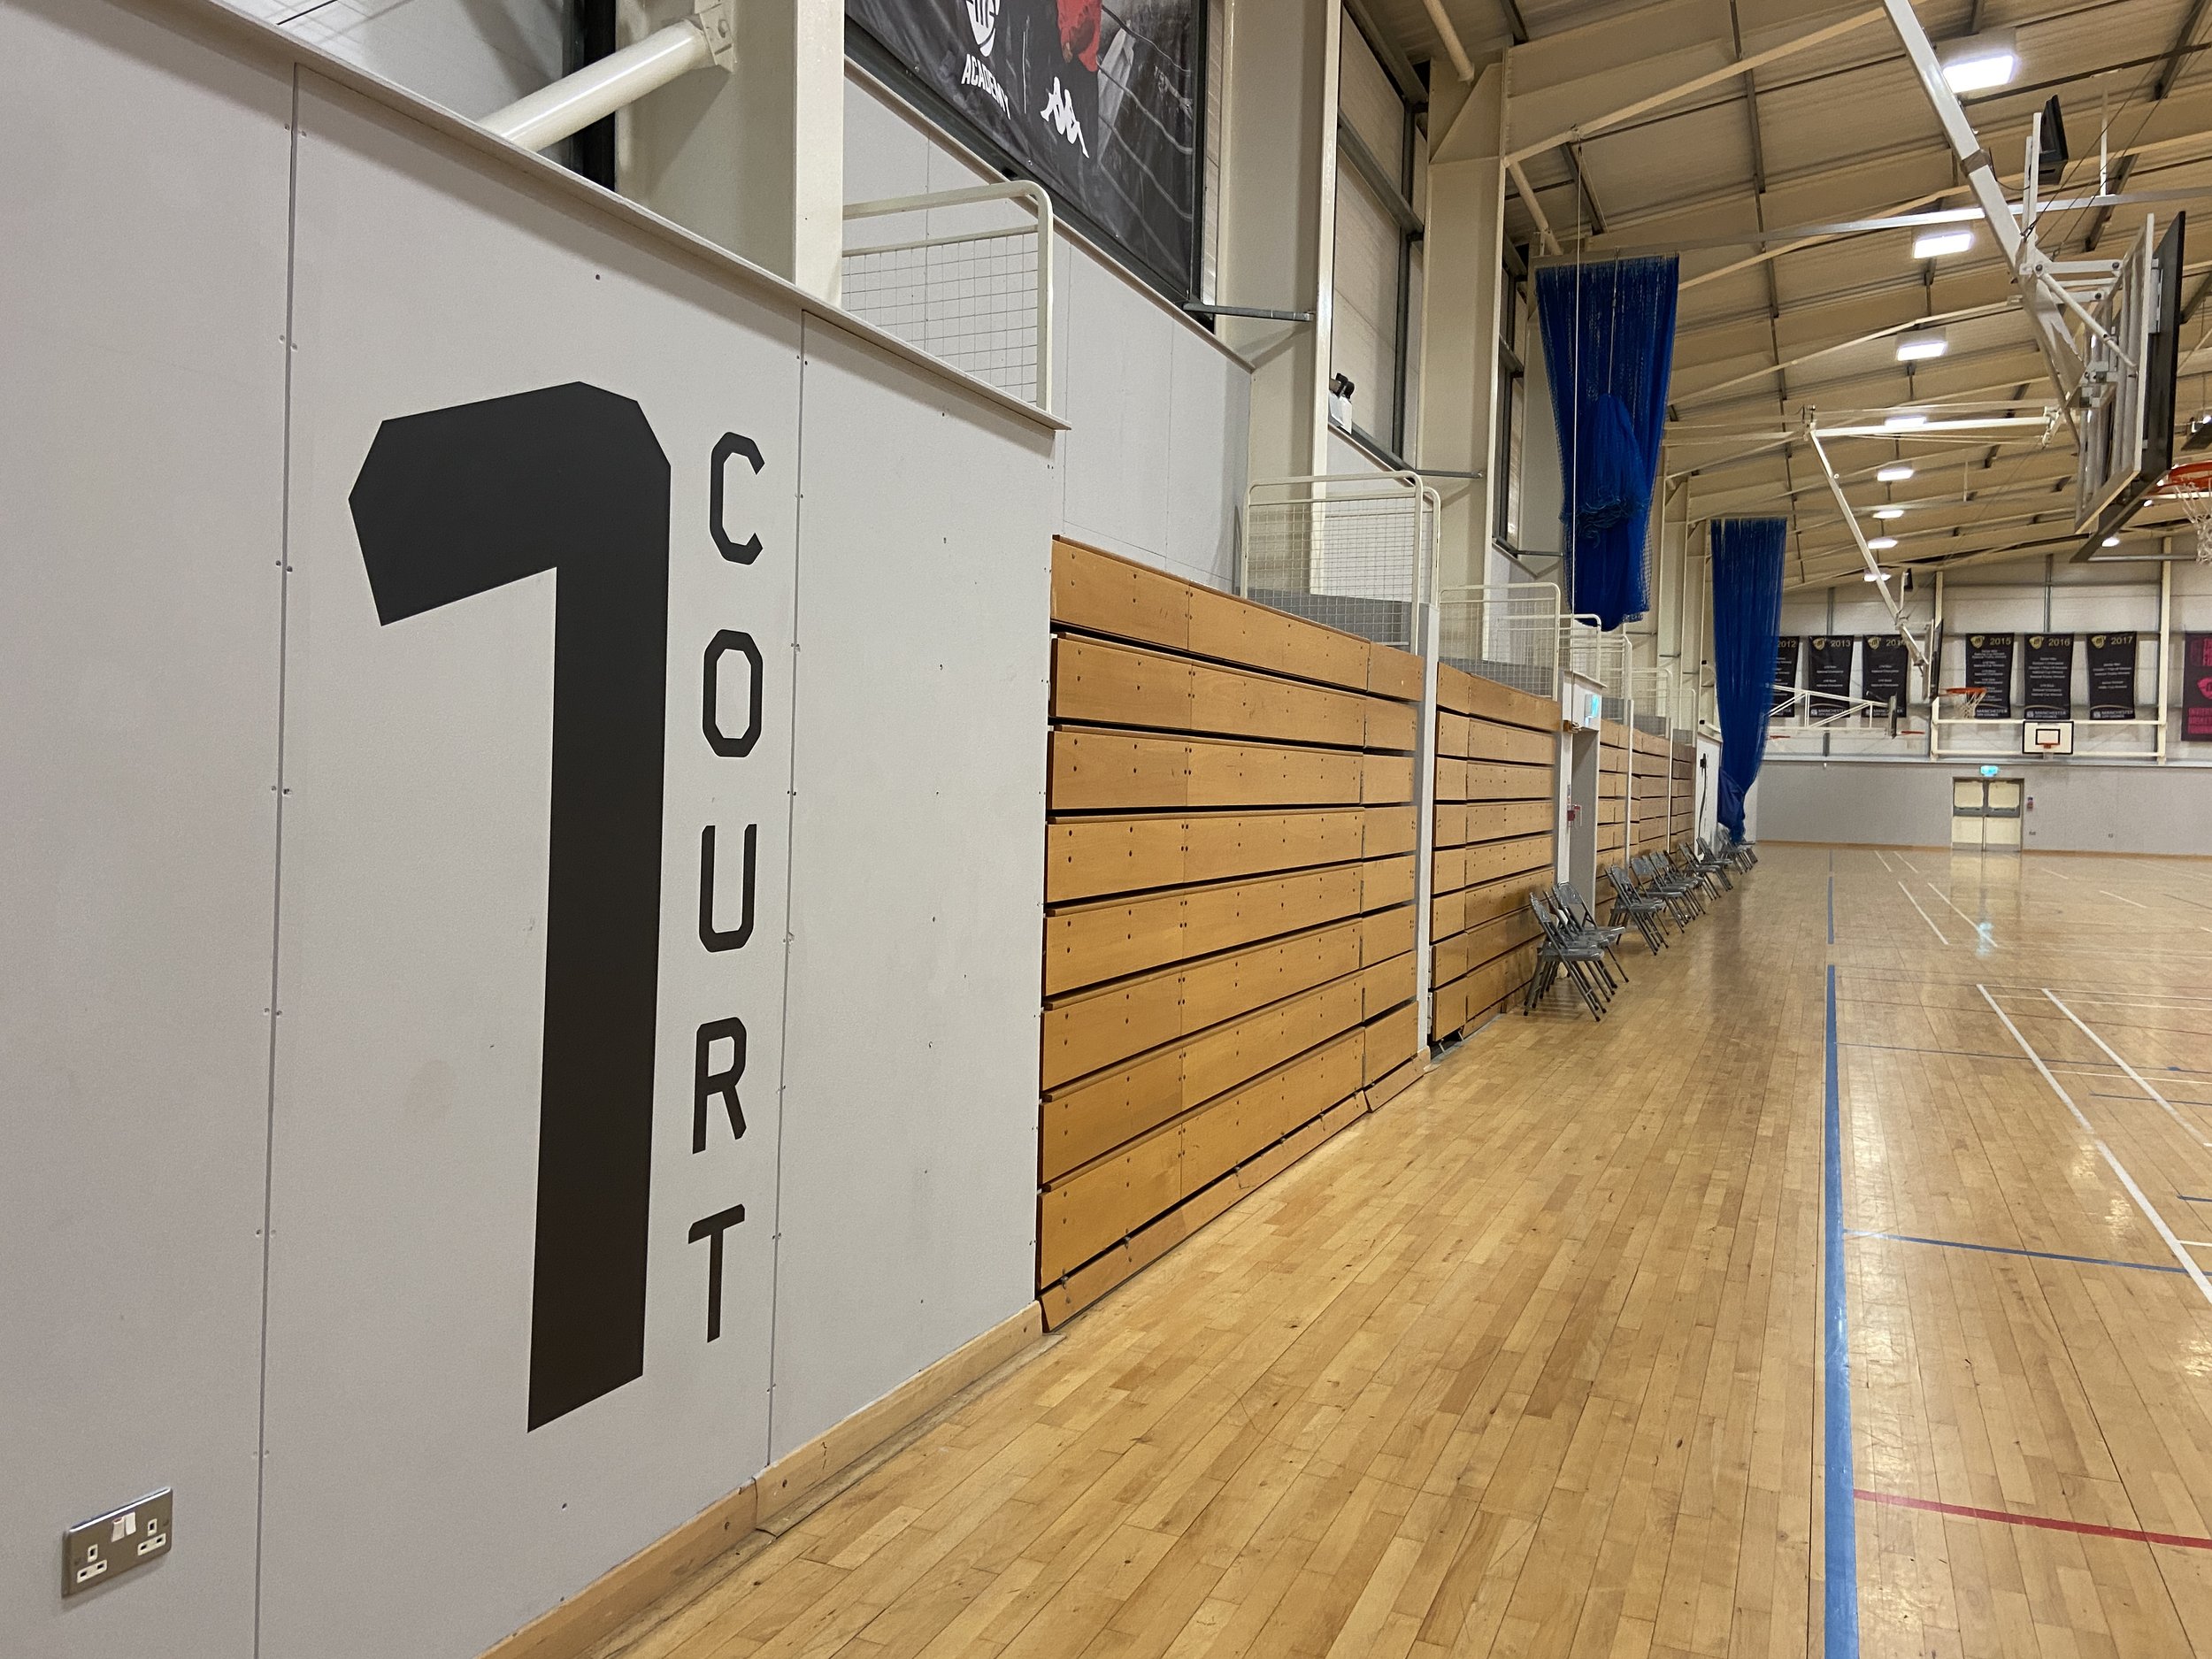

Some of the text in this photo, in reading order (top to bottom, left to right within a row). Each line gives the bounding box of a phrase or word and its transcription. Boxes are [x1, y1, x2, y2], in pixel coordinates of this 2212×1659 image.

[961, 53, 1010, 120] ACADEMY
[2048, 638, 2070, 647] 2016
[2110, 636, 2133, 645] 2017
[349, 381, 671, 1432] 1
[688, 432, 764, 1343] COURT
